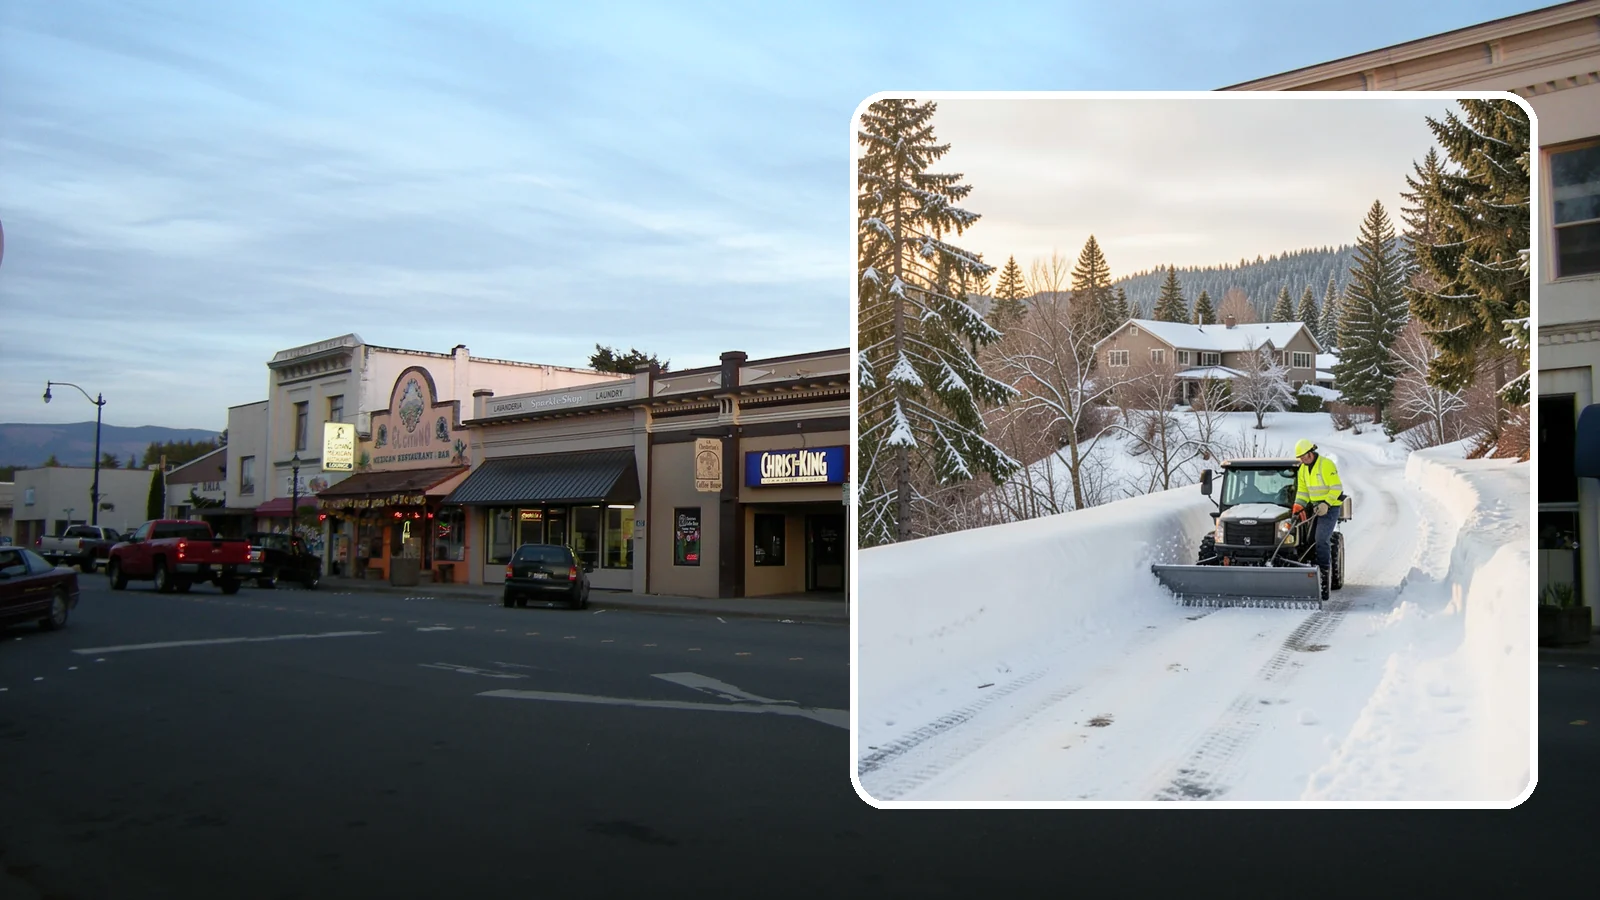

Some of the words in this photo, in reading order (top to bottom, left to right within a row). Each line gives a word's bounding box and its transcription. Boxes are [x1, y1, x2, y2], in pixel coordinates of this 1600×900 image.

[494, 402, 522, 412] LAVANDERIA
[596, 389, 624, 399] LAUNDRY
[373, 455, 396, 464] MEXICAN
[397, 452, 433, 462] RESTAURANT
[438, 450, 450, 458] BAR
[696, 480, 709, 488] Coffee
[710, 480, 722, 488] House
